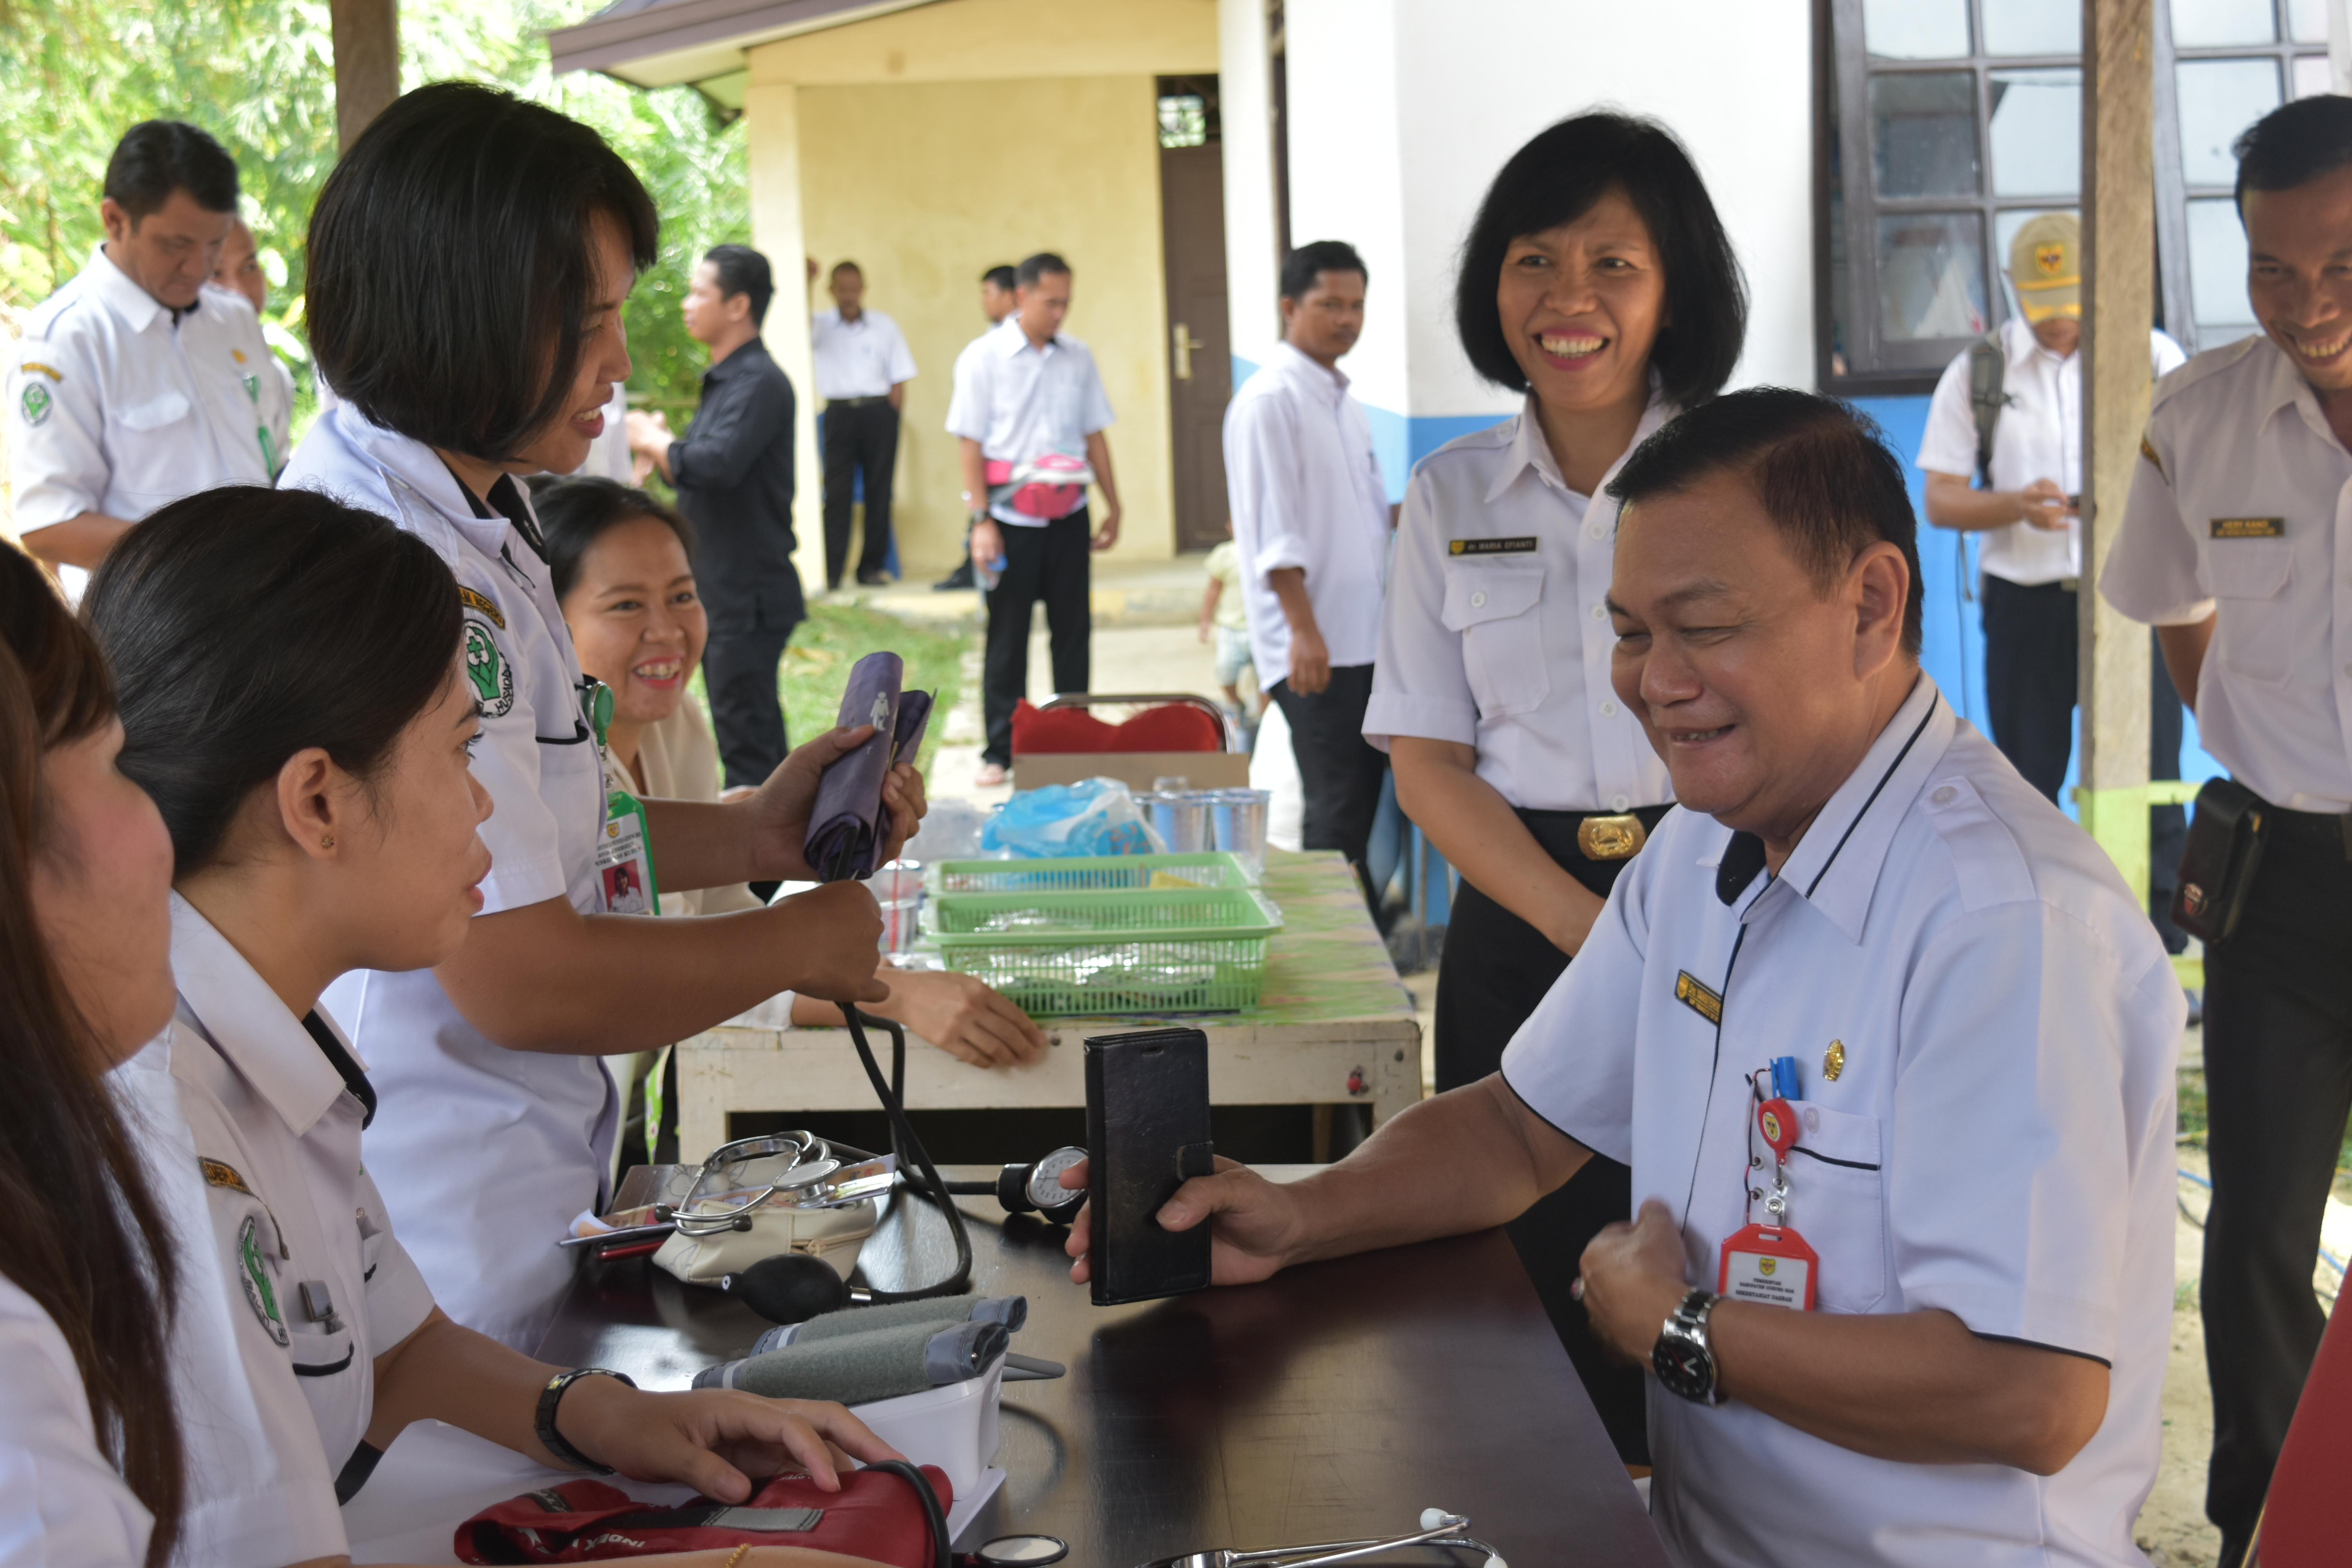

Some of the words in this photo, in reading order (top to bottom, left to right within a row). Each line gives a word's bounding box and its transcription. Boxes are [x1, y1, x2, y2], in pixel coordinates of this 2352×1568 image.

[1478, 542, 1501, 550] MARIA
[495, 669, 511, 713] HUSADA
[1736, 1290, 1770, 1299] SEKRETARIAT
[584, 1534, 645, 1550] INDEX
